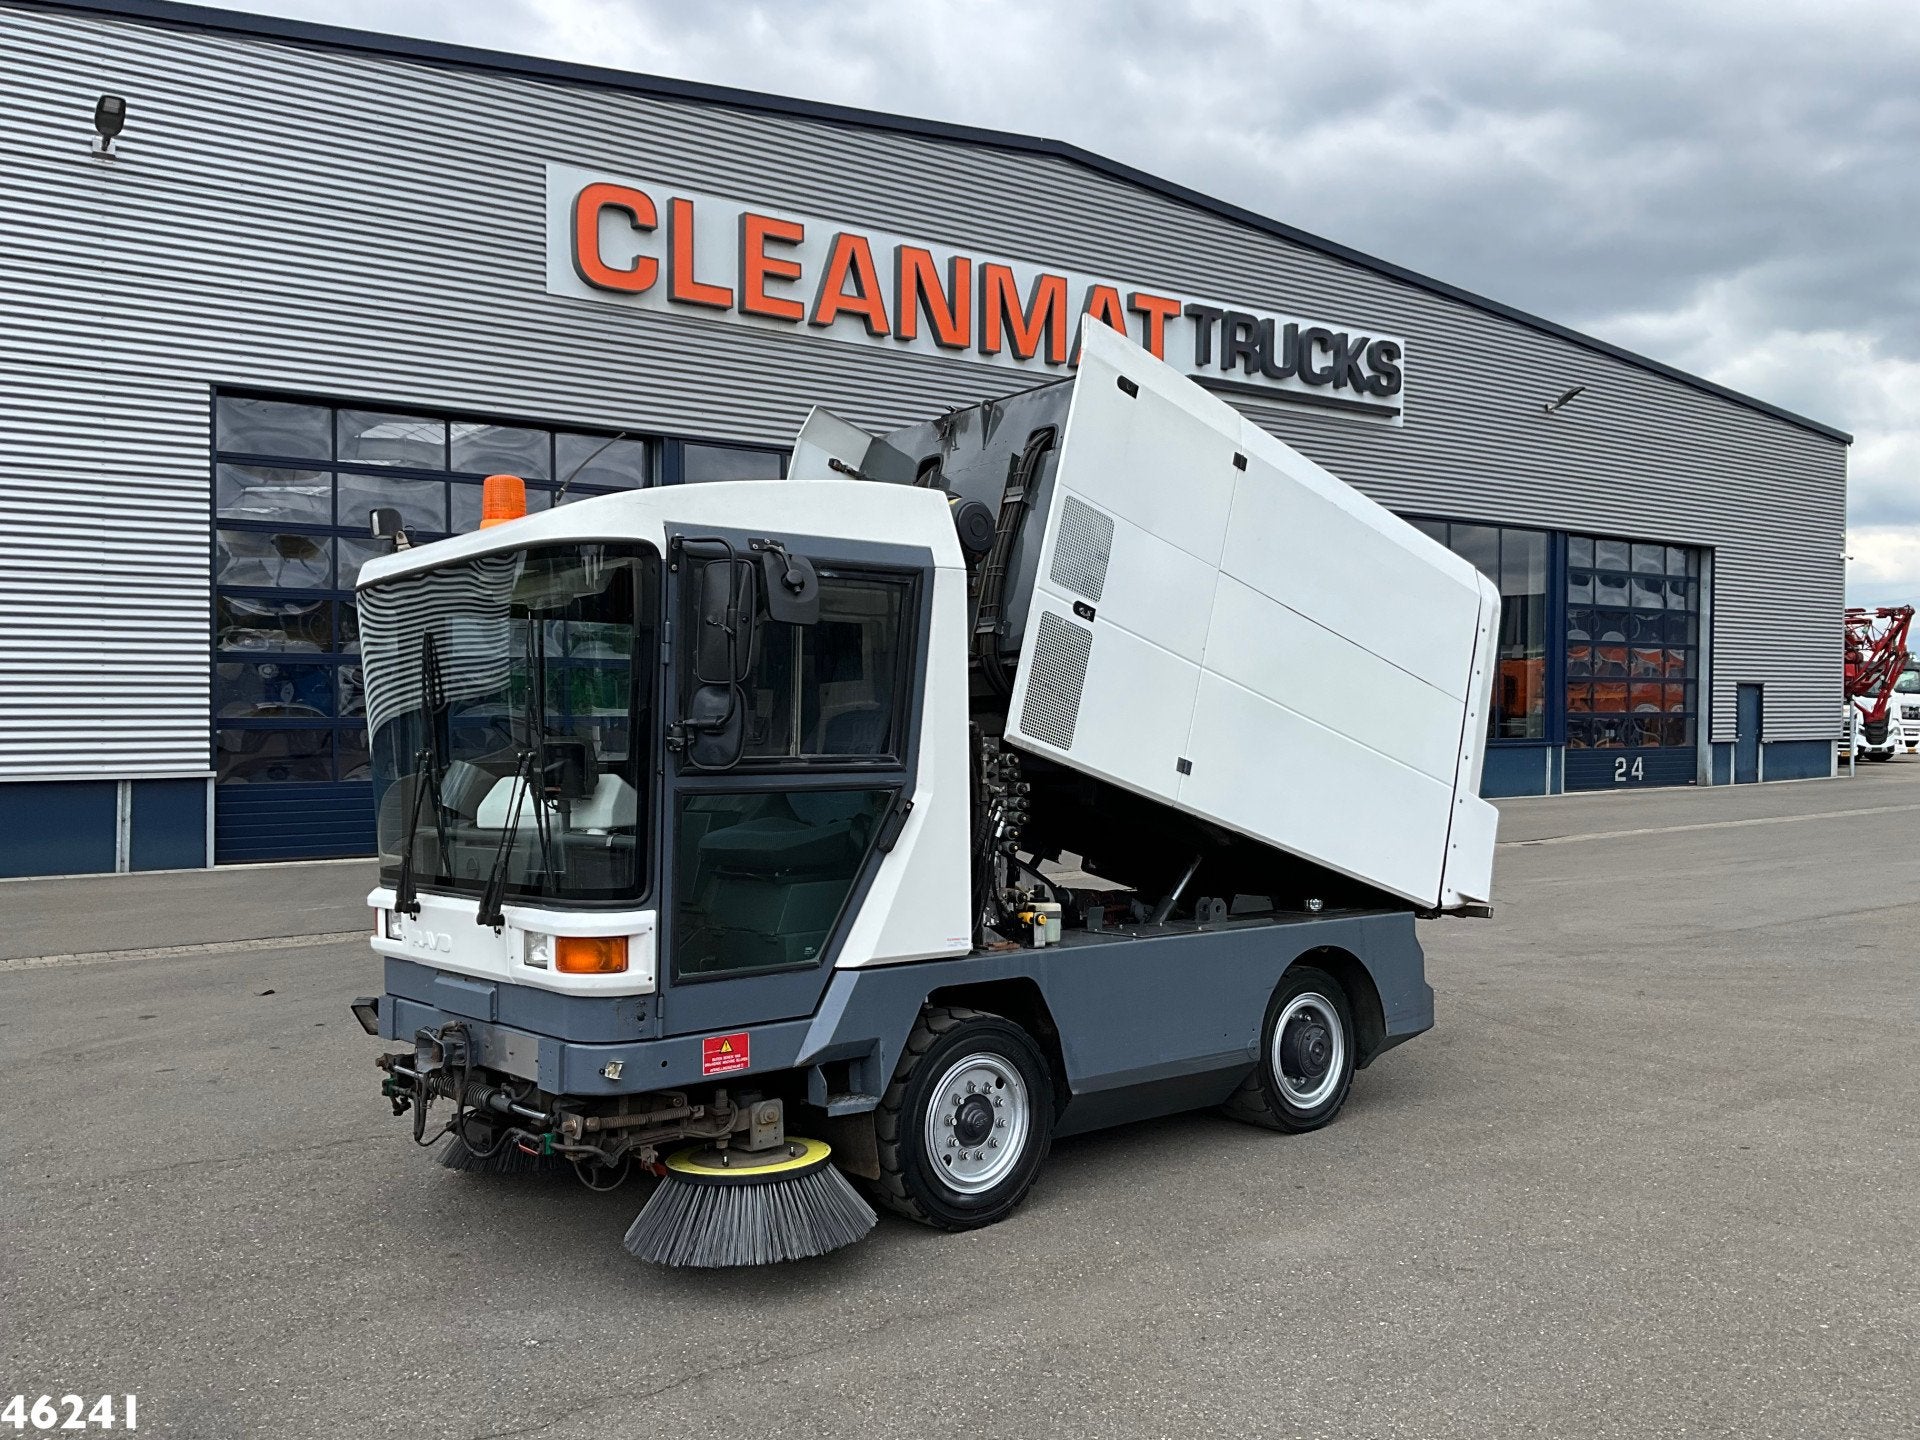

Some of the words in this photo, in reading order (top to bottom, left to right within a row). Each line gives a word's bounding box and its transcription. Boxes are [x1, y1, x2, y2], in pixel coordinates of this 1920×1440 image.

[570, 182, 1181, 368] CLEANMAT
[1184, 303, 1401, 396] TRUCKS
[1615, 757, 1644, 781] 24
